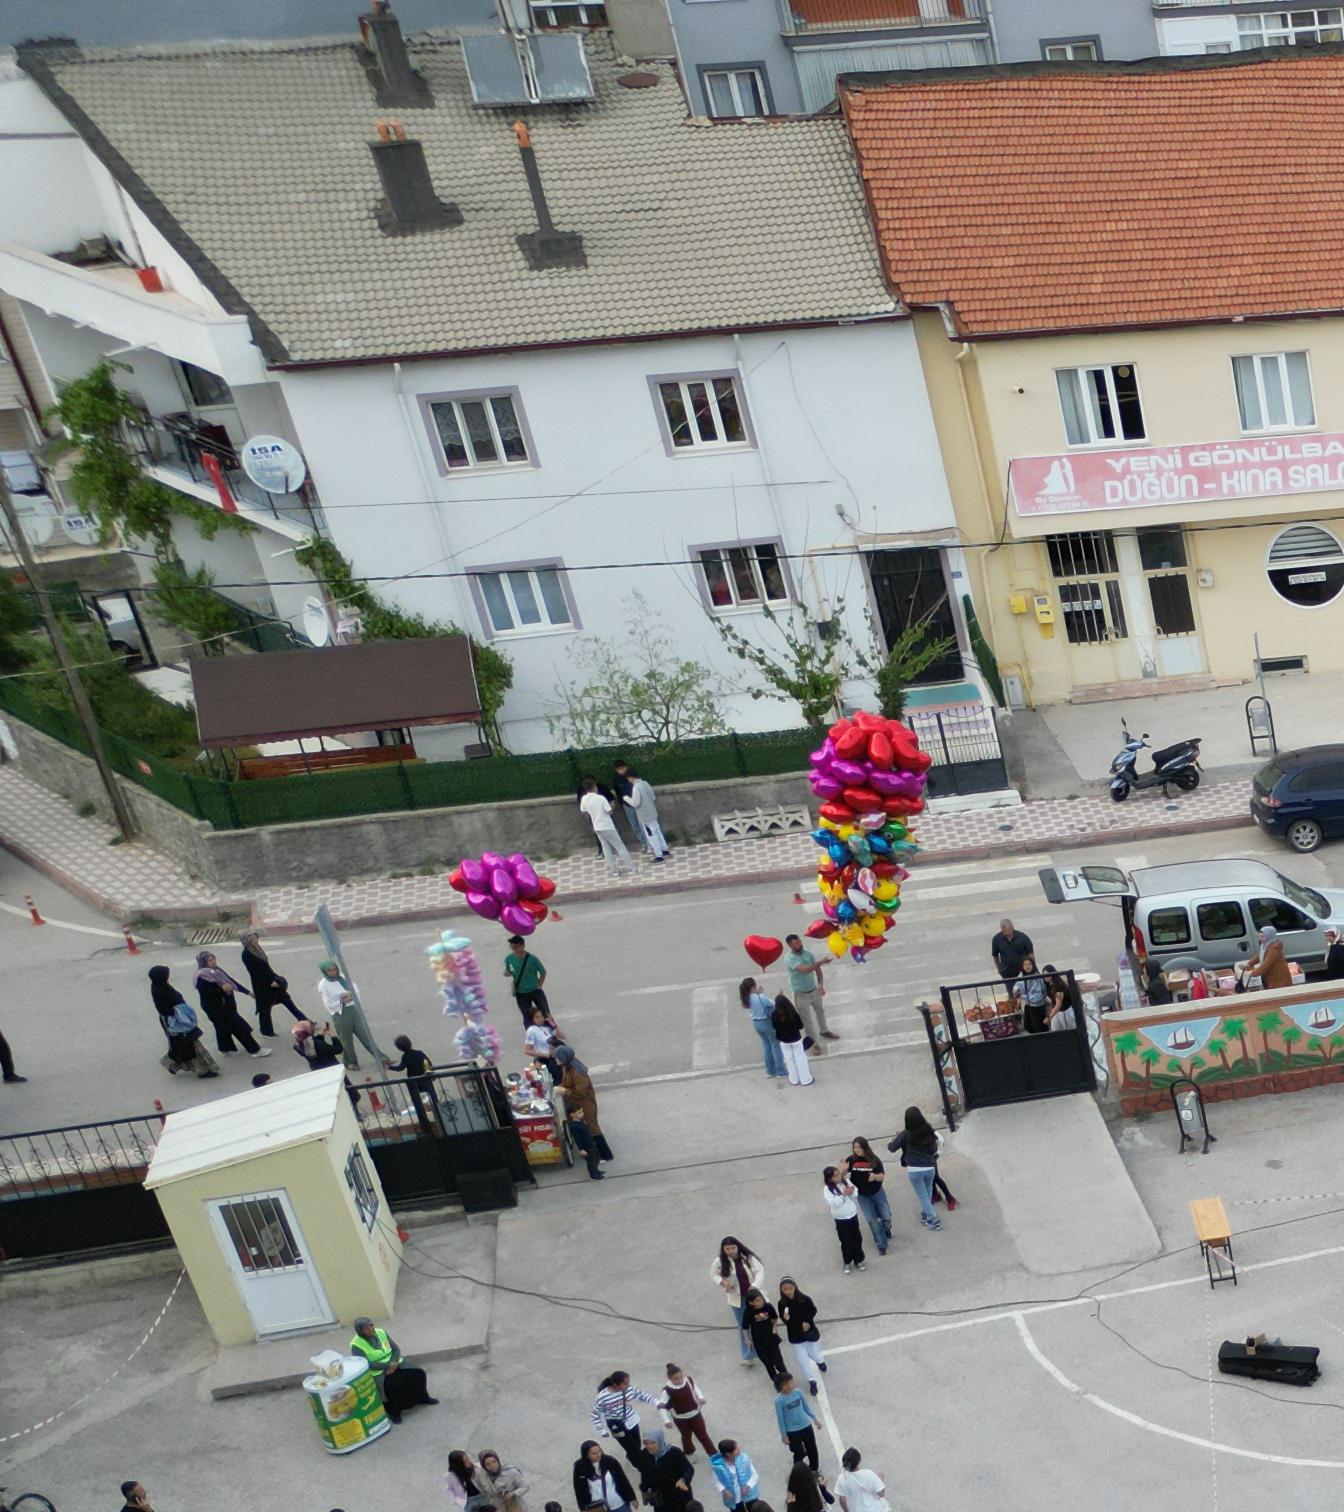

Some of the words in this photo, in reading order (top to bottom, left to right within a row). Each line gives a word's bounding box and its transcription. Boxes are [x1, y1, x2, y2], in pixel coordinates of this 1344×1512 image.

[1105, 448, 1182, 473] YENİ
[1104, 473, 1198, 504] DÜĞÜN
[1222, 466, 1282, 495] KINA
